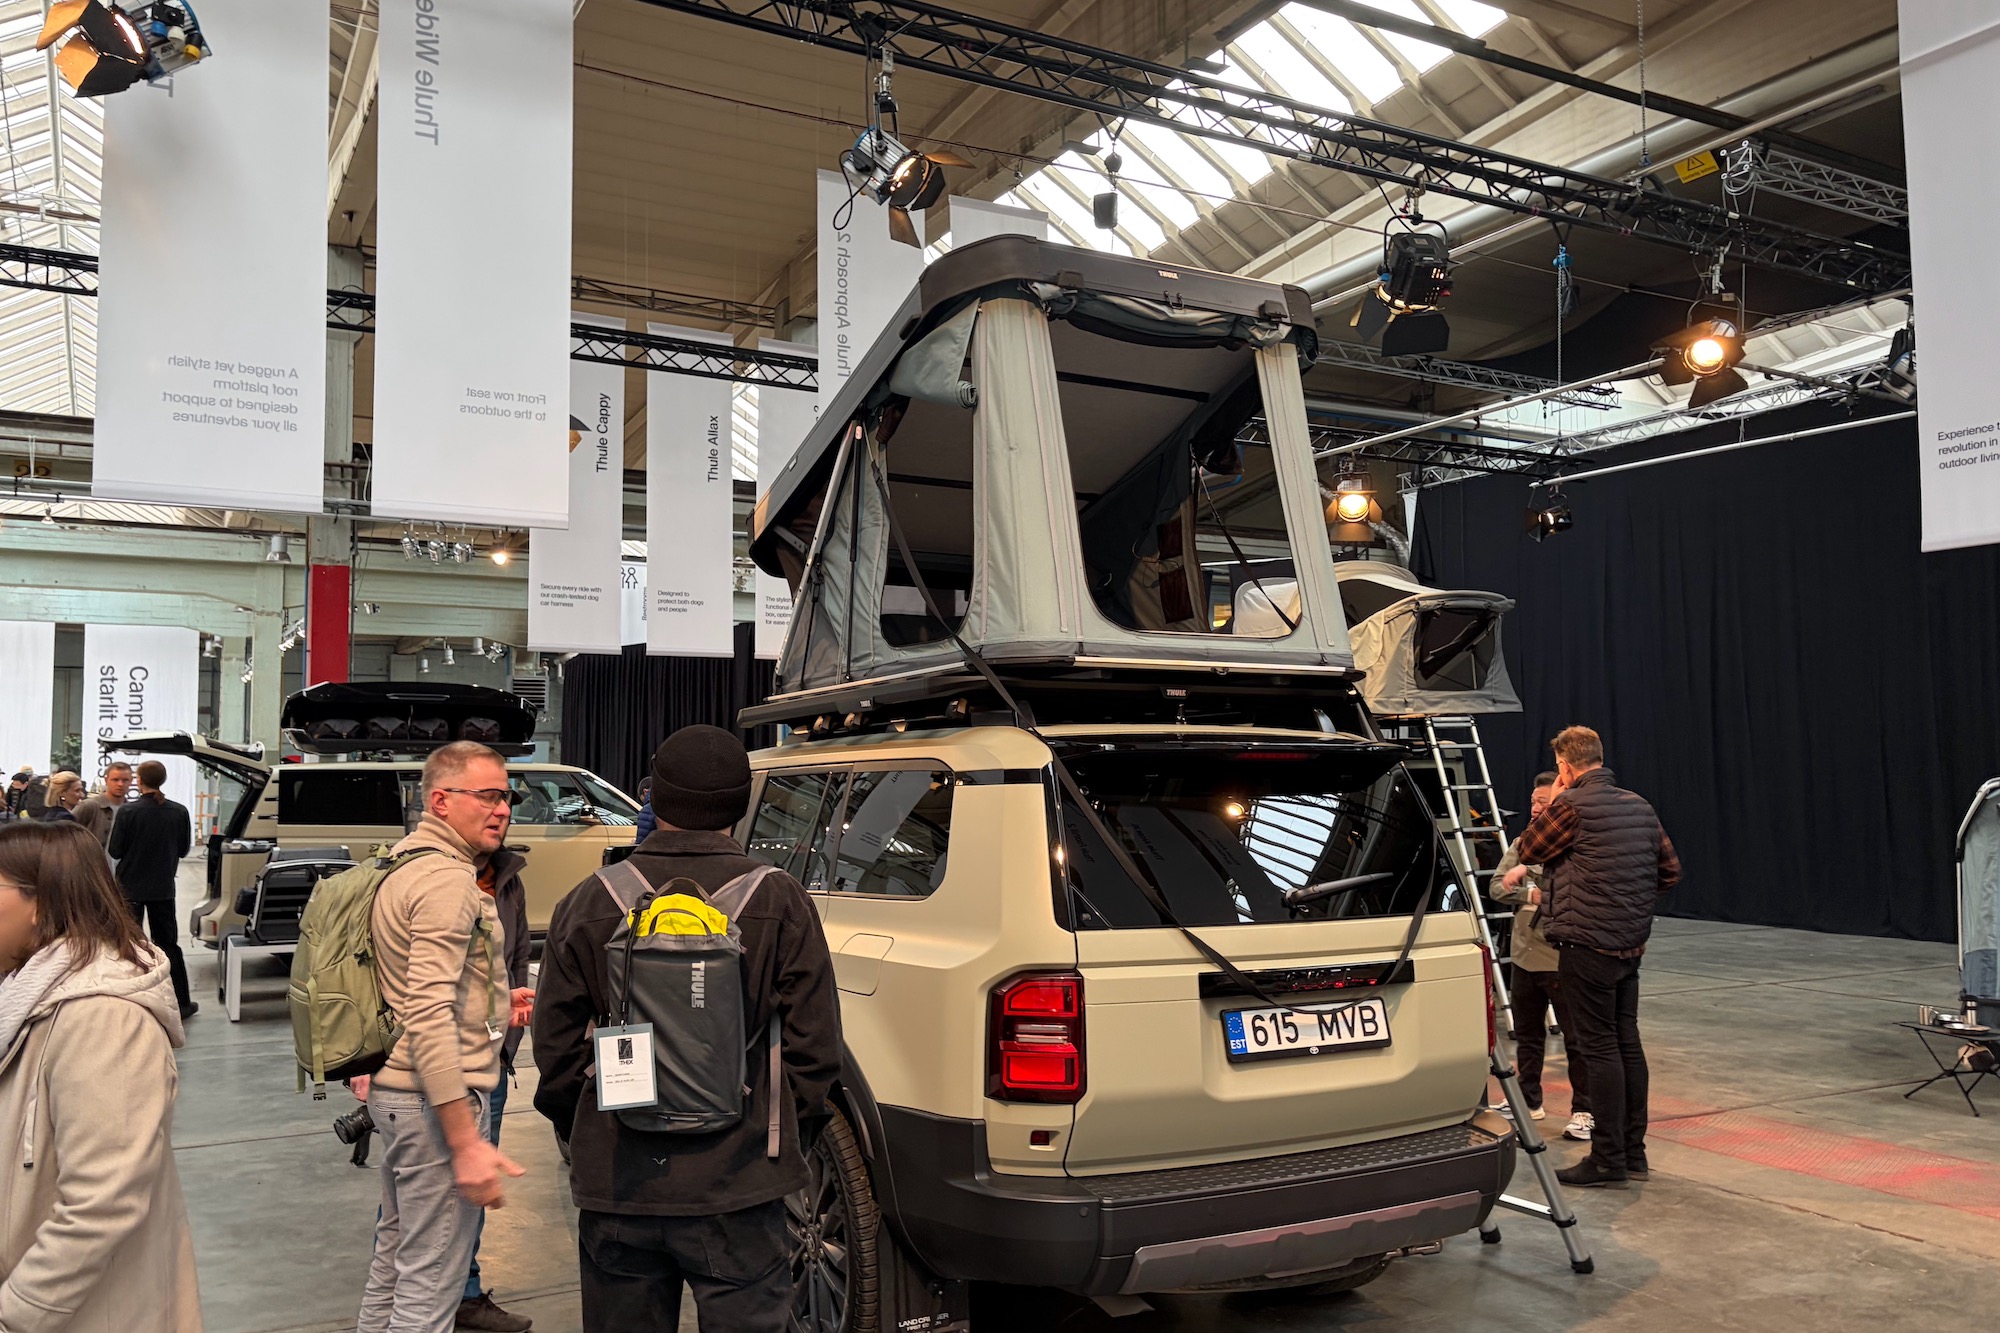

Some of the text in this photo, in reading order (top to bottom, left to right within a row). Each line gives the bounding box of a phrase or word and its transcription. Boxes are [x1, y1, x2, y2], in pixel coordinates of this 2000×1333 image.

[596, 392, 611, 473] Thule Cappy
[1938, 424, 1994, 440] Experience
[1938, 437, 1998, 455] revolution in
[708, 415, 718, 482] Thule Allax
[1939, 457, 1978, 469] outdoor
[657, 590, 683, 598] Designed
[98, 665, 119, 720] starlit
[124, 666, 149, 731] Campi
[691, 960, 705, 1008] THULE
[1251, 1005, 1379, 1047] 615 MVB
[1230, 1038, 1246, 1049] EST
[898, 1318, 918, 1328] LAND
